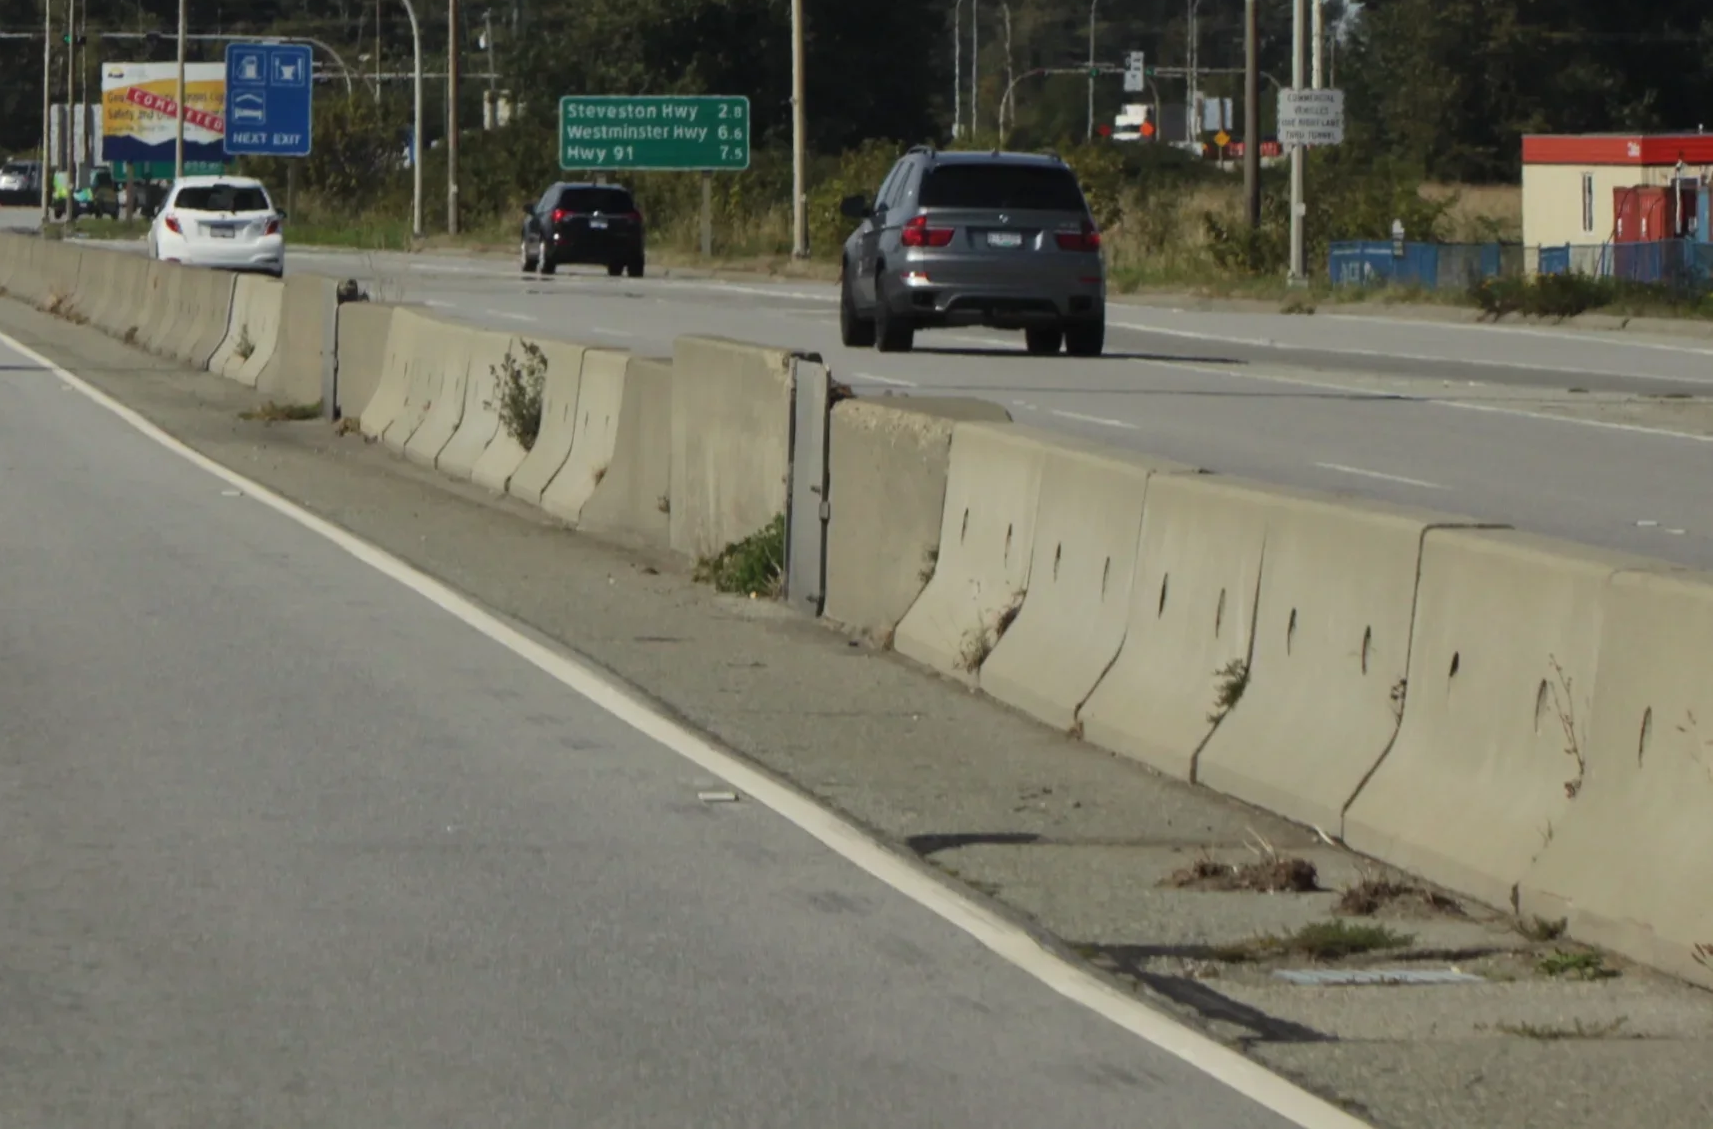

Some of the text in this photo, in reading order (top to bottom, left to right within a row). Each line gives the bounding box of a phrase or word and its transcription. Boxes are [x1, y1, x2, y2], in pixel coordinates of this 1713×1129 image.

[133, 90, 223, 131] COMPETED
[567, 102, 657, 119] Steveston
[662, 104, 699, 122] Hwy
[232, 132, 302, 145] NEXT EXIT
[567, 123, 669, 140] Westminster
[673, 125, 708, 143] Hwy
[567, 146, 606, 164] Hwy
[613, 146, 634, 161] 91
